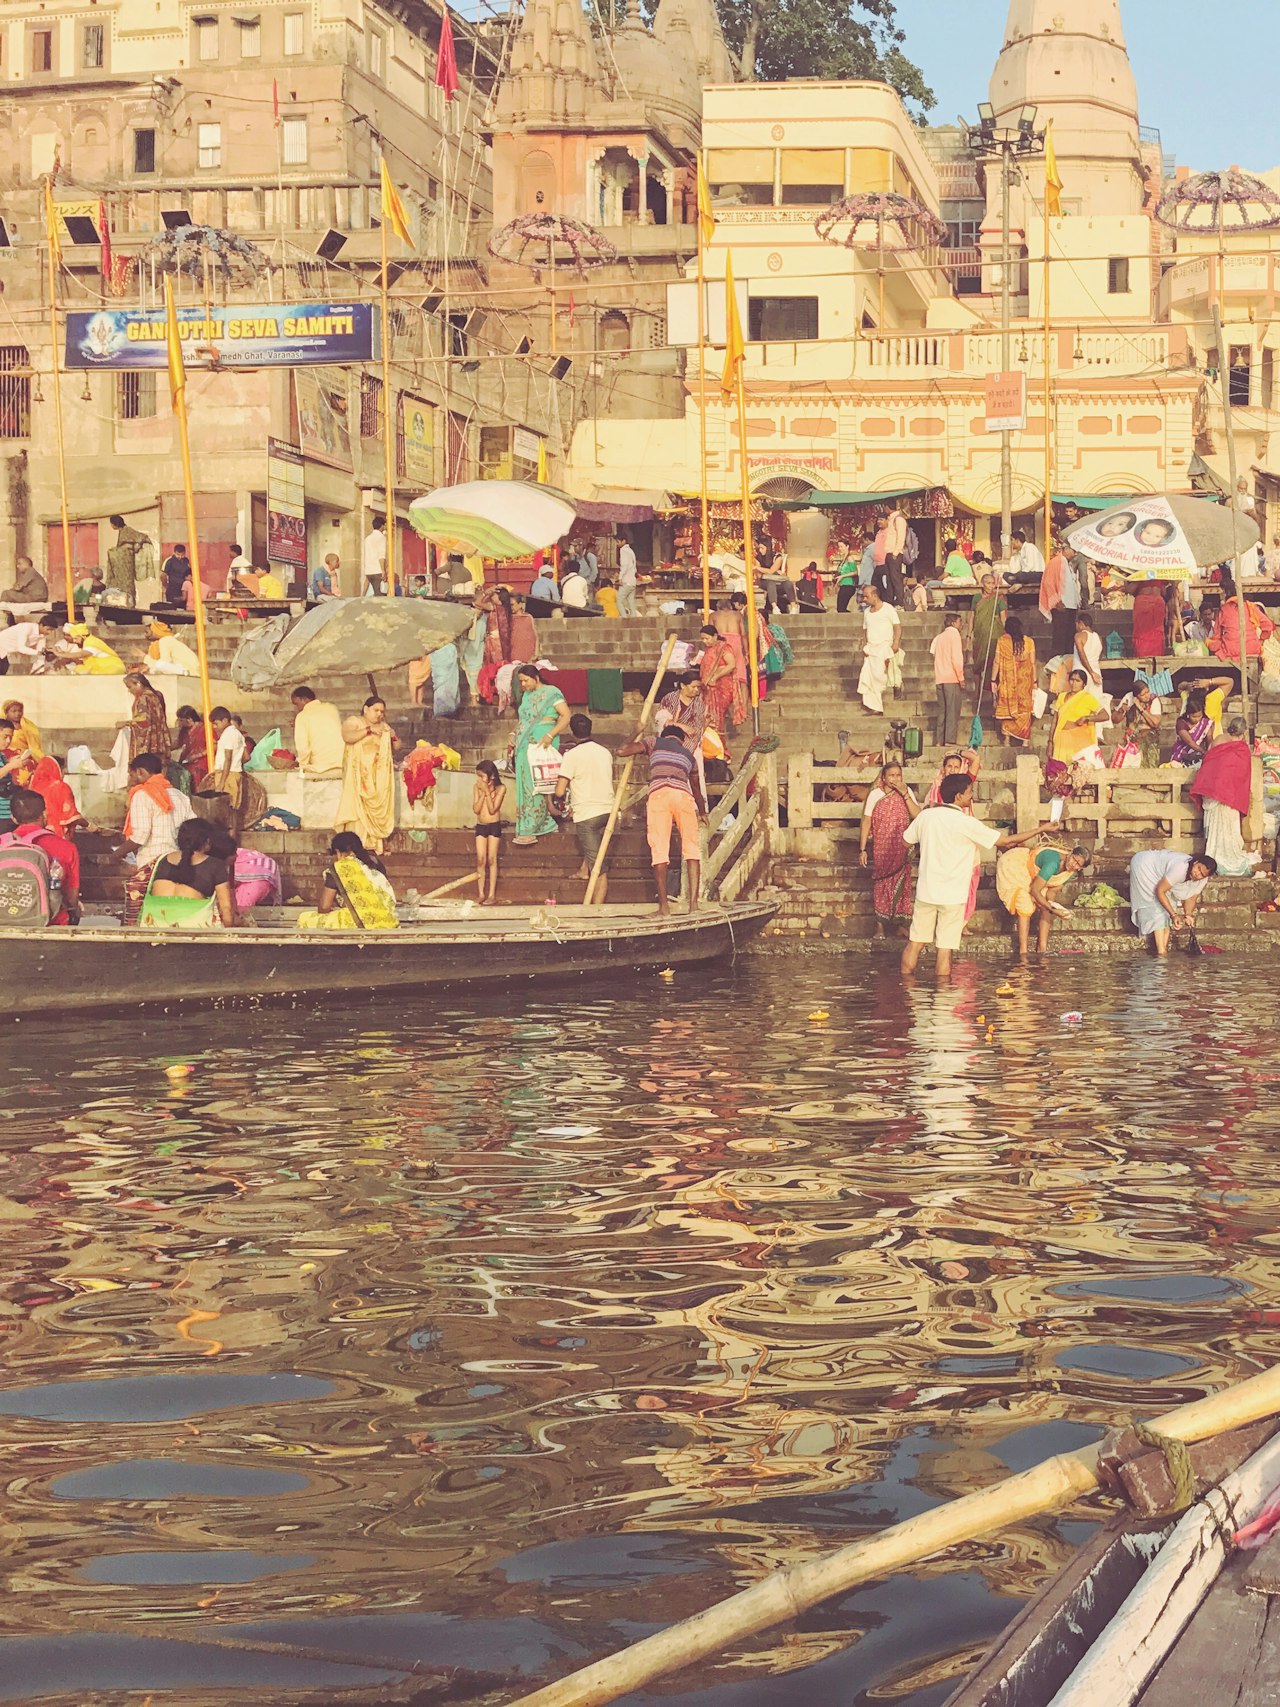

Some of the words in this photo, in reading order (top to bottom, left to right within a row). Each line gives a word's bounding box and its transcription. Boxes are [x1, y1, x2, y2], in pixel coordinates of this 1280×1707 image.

[228, 318, 279, 339] SEVA
[283, 315, 354, 337] SAMITI
[267, 349, 304, 360] Varanasi
[1128, 506, 1171, 518] SURGERY
[1142, 502, 1167, 511] FREE
[1083, 538, 1129, 562] MEMORIAL
[1131, 555, 1185, 566] HOSPITAL
